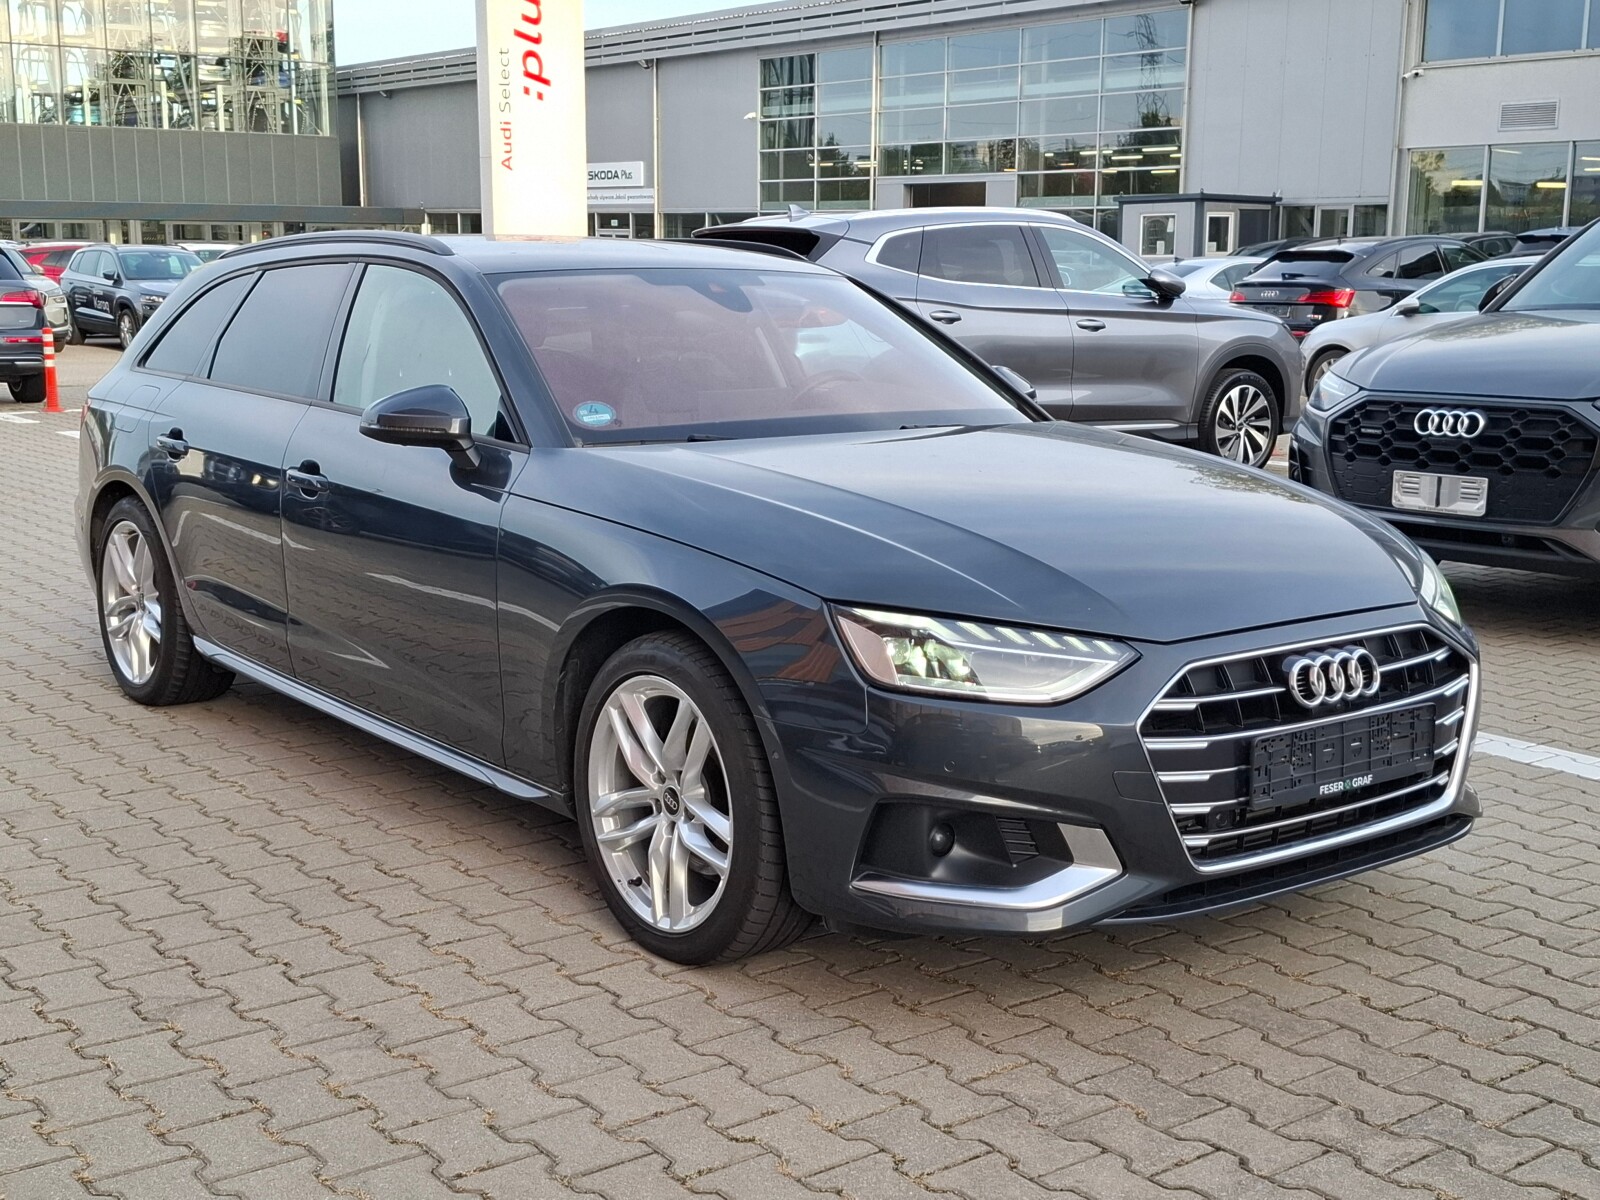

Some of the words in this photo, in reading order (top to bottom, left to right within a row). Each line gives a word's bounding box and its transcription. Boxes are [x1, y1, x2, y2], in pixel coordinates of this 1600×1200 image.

[499, 47, 511, 113] Select
[500, 121, 513, 171] Audi
[588, 169, 620, 181] SKODA
[620, 169, 633, 180] Plus
[1319, 781, 1344, 795] FESER
[1352, 774, 1373, 788] GRAF
